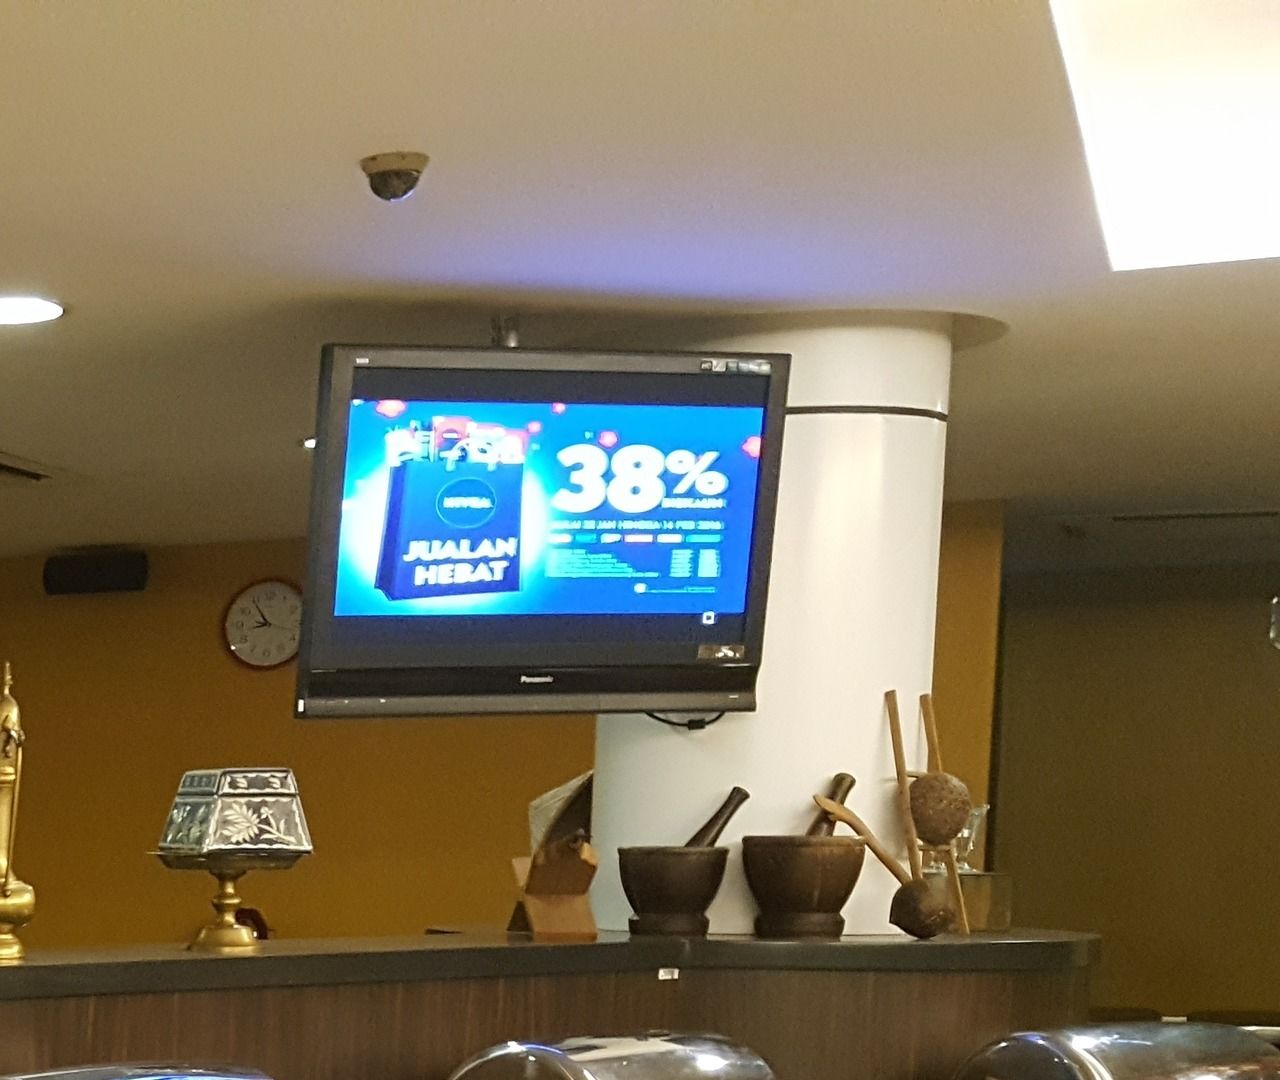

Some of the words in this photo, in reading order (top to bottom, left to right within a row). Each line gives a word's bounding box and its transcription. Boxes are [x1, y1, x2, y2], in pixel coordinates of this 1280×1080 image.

[550, 443, 729, 514] 38%
[402, 536, 518, 563] JUALAN
[413, 560, 510, 587] HEBAT
